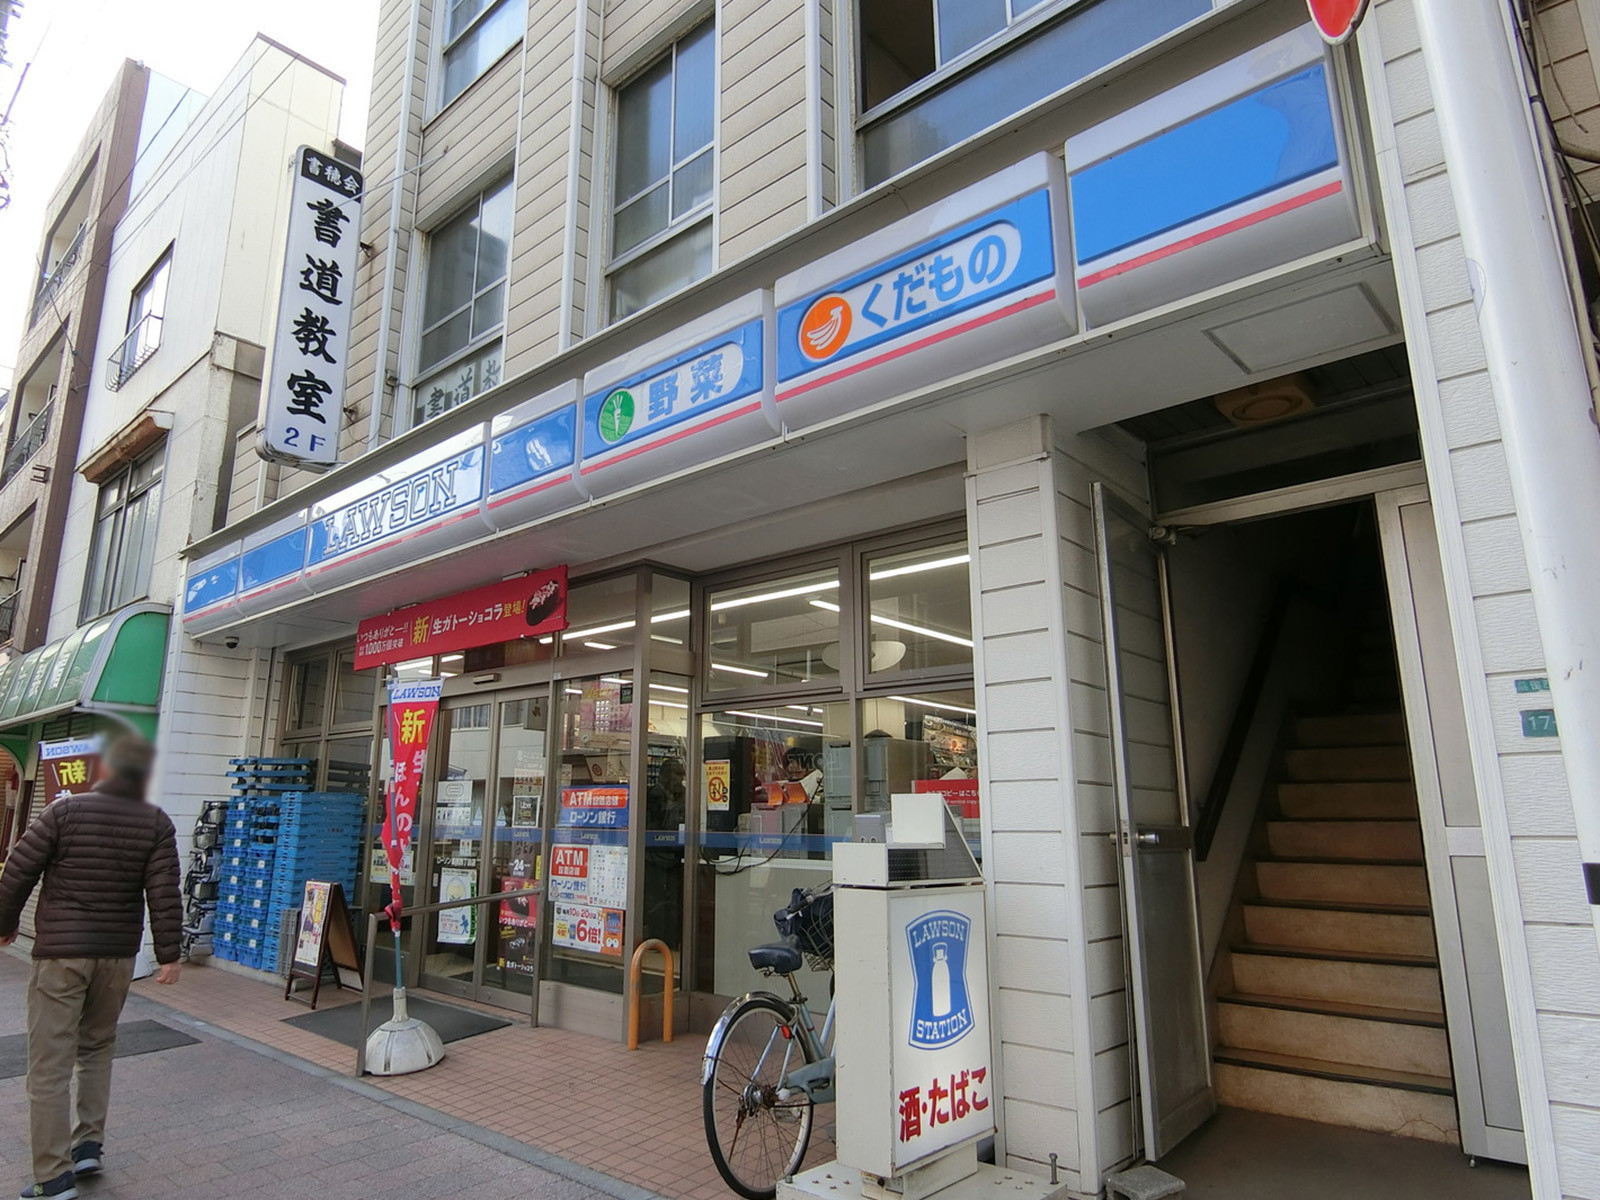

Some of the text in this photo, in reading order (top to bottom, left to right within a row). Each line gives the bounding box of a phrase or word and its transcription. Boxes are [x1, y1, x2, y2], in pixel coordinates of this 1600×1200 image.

[861, 234, 1007, 328] くだもの
[286, 198, 350, 424] 書道教室
[647, 352, 724, 421] 野菜
[284, 426, 327, 452] 2F
[323, 461, 459, 556] LAWSON
[413, 615, 429, 644] 新
[393, 685, 441, 700] LAWSON
[402, 708, 425, 744] 新
[570, 810, 616, 825] ローソン銀行
[513, 859, 525, 871] 24
[556, 850, 584, 866] ATM
[912, 920, 965, 948] LAWSON
[916, 1008, 968, 1040] STATION
[899, 1066, 989, 1143] 酒・たばこ
